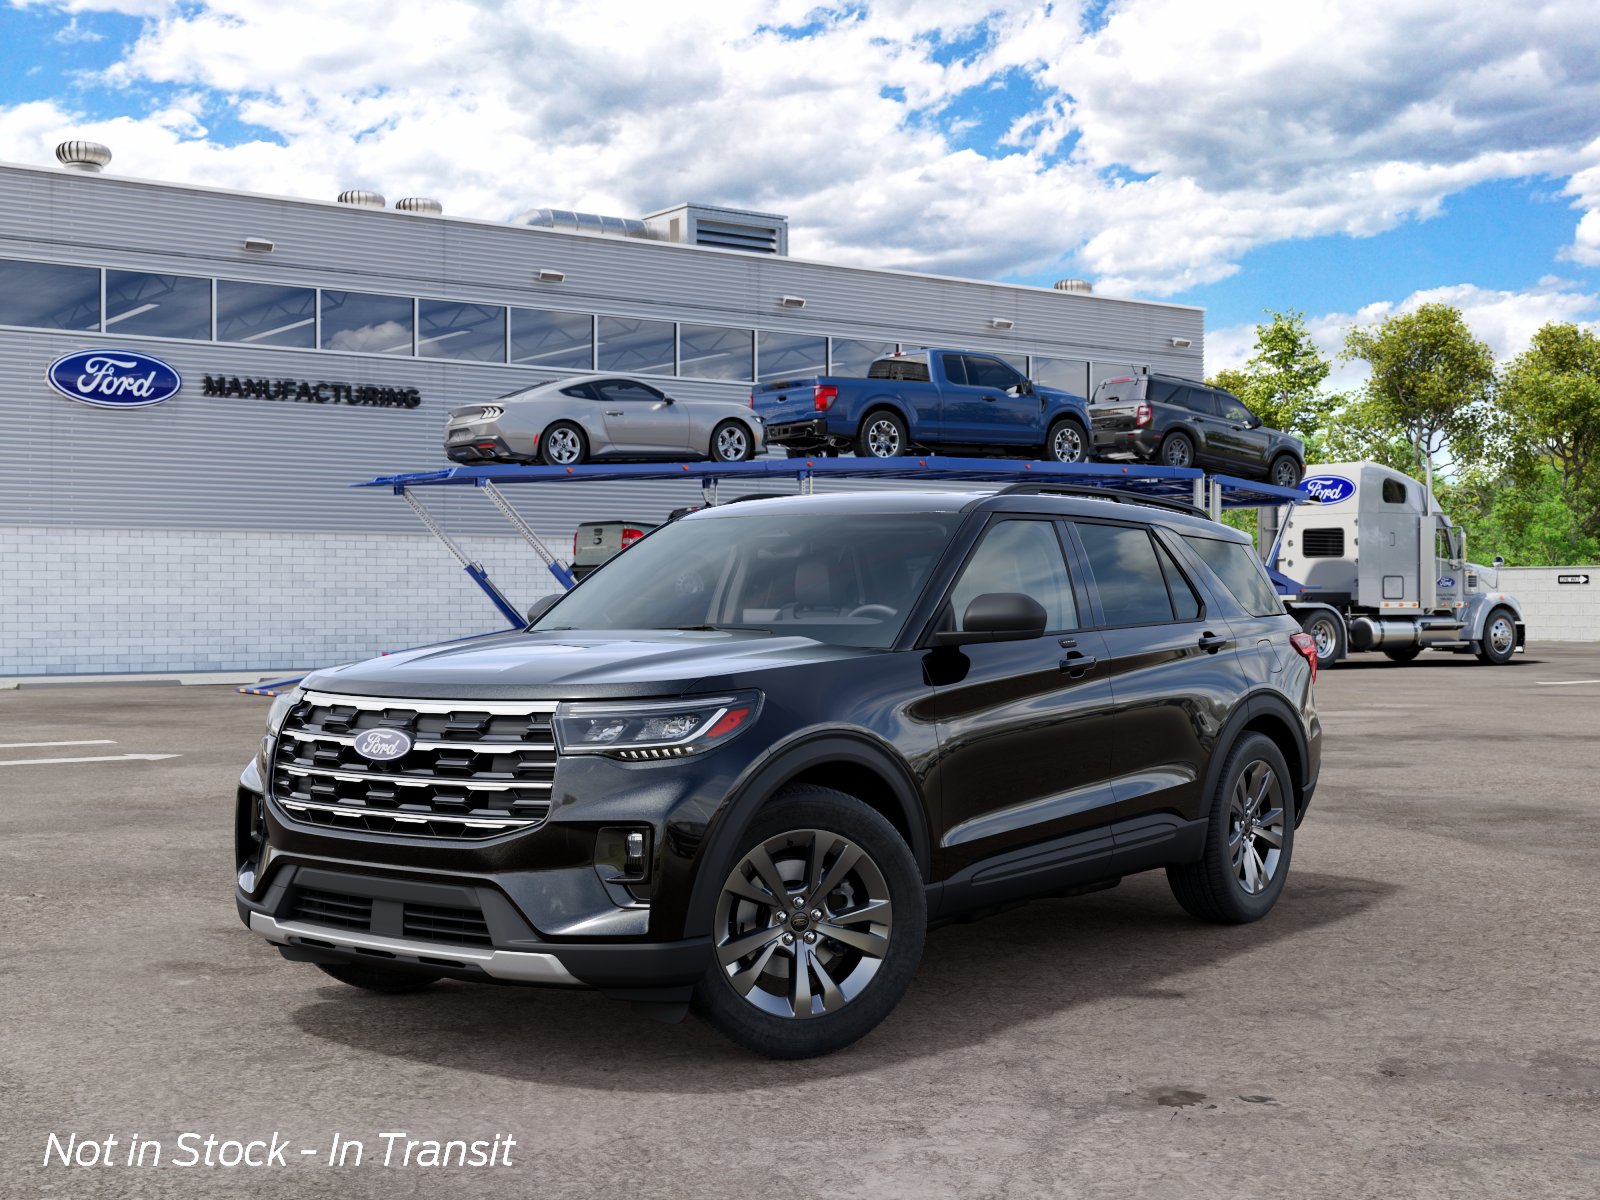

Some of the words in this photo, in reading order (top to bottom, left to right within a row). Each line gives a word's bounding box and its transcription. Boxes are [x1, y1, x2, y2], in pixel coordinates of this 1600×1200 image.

[77, 357, 156, 397] Ford
[204, 374, 421, 408] MANUFACTURING
[1306, 480, 1343, 499] Ford
[362, 732, 400, 755] Ford
